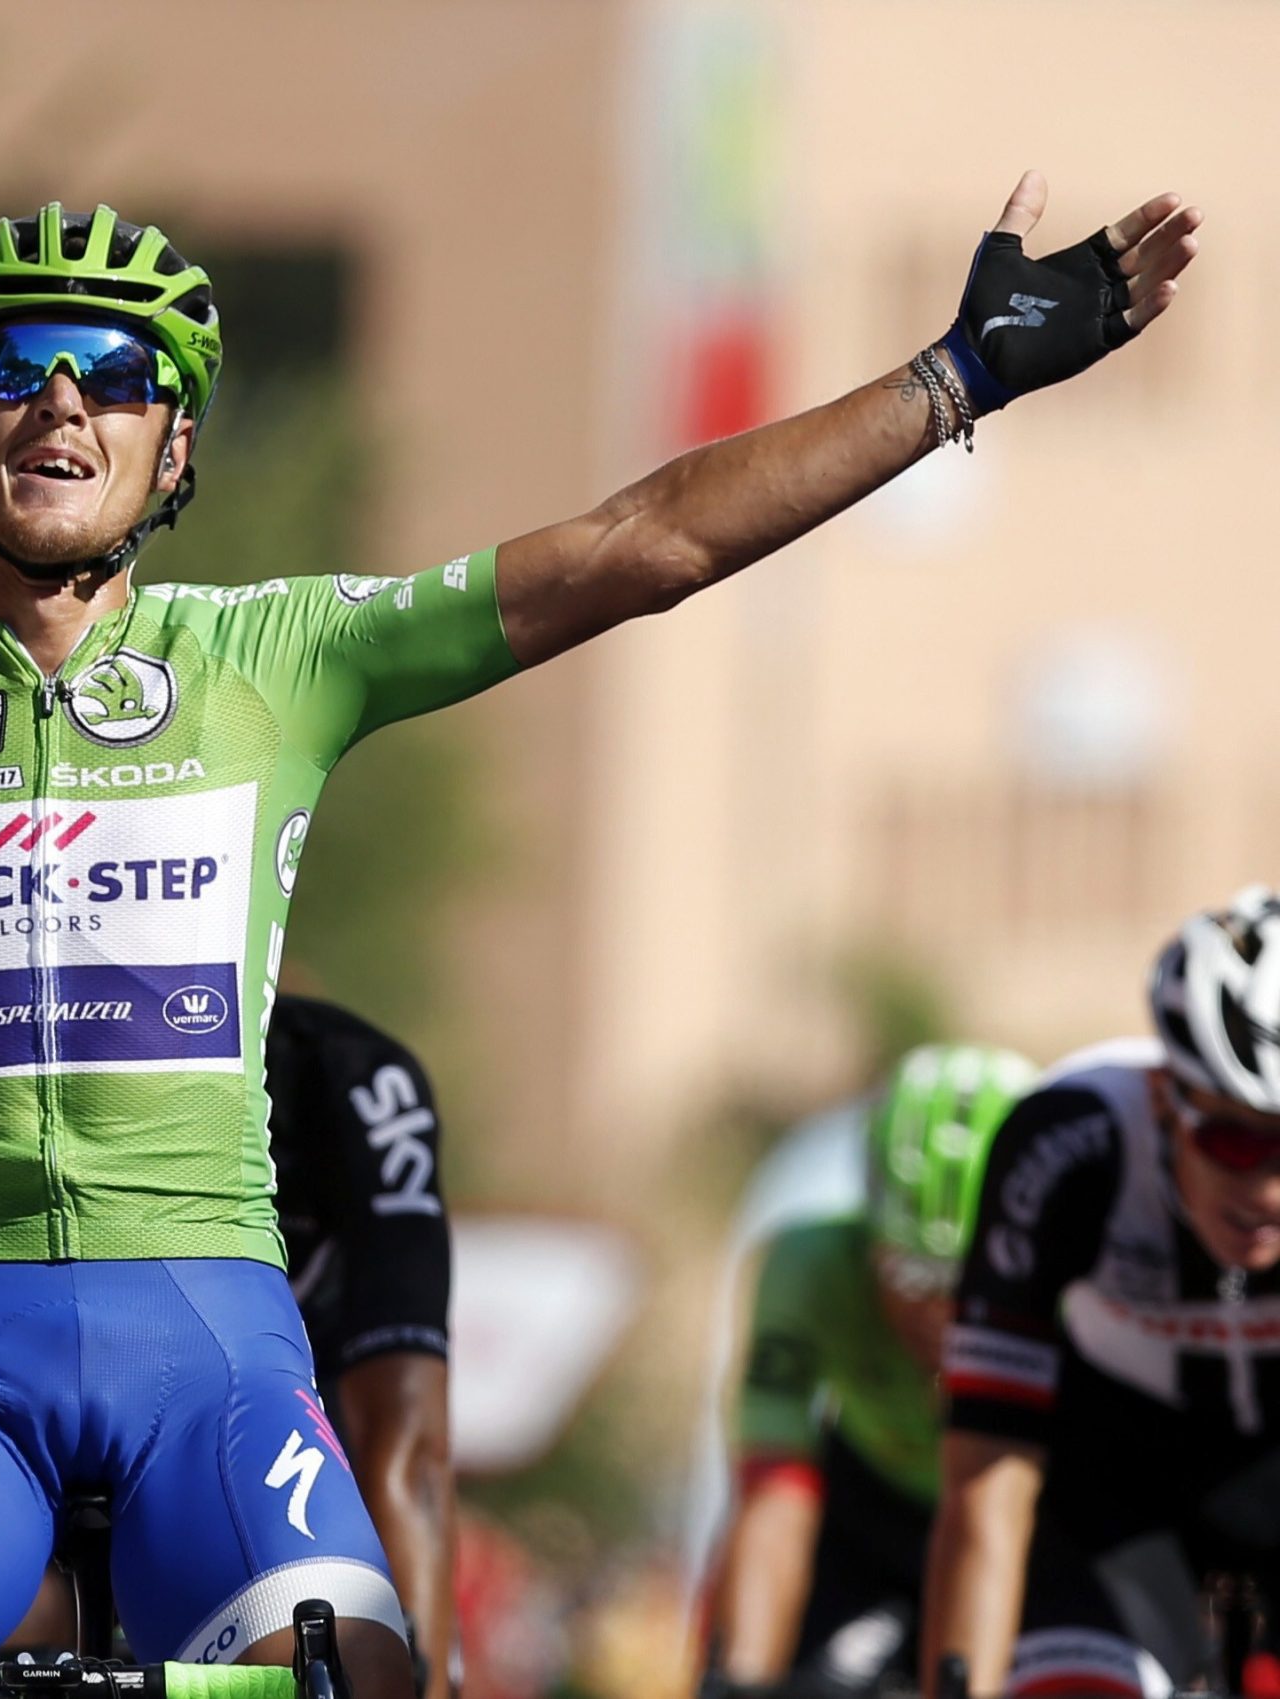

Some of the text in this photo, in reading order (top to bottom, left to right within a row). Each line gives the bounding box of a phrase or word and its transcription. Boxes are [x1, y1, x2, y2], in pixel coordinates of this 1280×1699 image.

[0, 769, 17, 786] 17
[172, 1013, 219, 1025] vermarc
[348, 1063, 442, 1218] SKY
[23, 1670, 61, 1679] GARMIN
